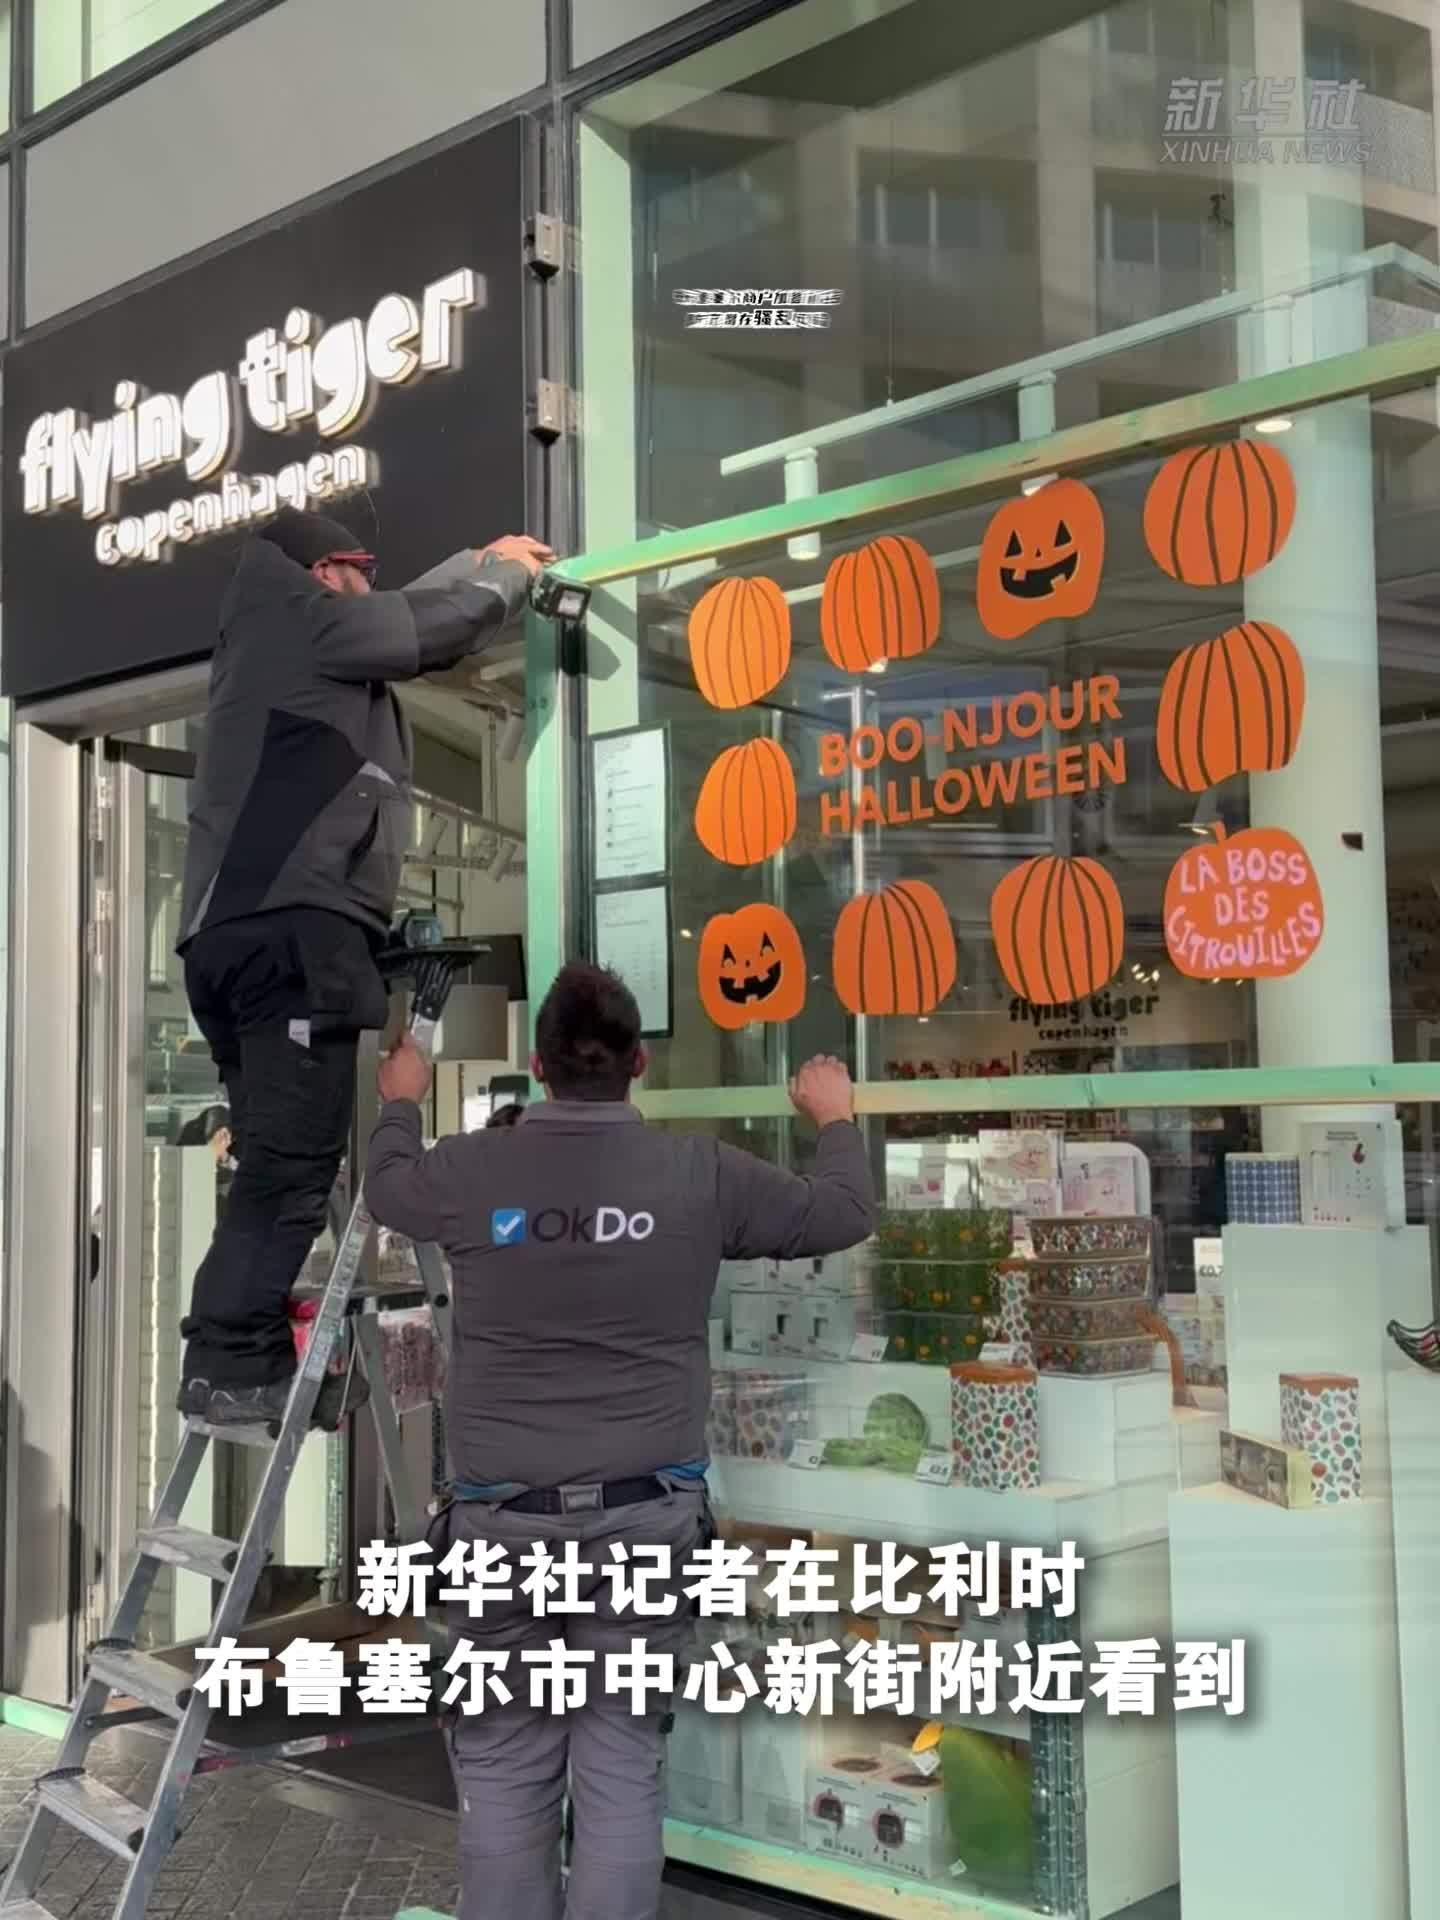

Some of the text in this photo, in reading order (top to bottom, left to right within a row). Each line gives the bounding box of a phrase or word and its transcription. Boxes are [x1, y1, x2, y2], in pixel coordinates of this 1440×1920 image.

[19, 267, 477, 520] flying tiger
[96, 444, 370, 565] copenhagen
[819, 736, 1127, 836] HALLOWEEN
[1180, 847, 1308, 895] LA BOSS
[1167, 901, 1322, 970] CITROUILLES
[1214, 887, 1270, 926] DES
[1090, 991, 1160, 1021] tiger
[532, 1204, 655, 1244] OkDo
